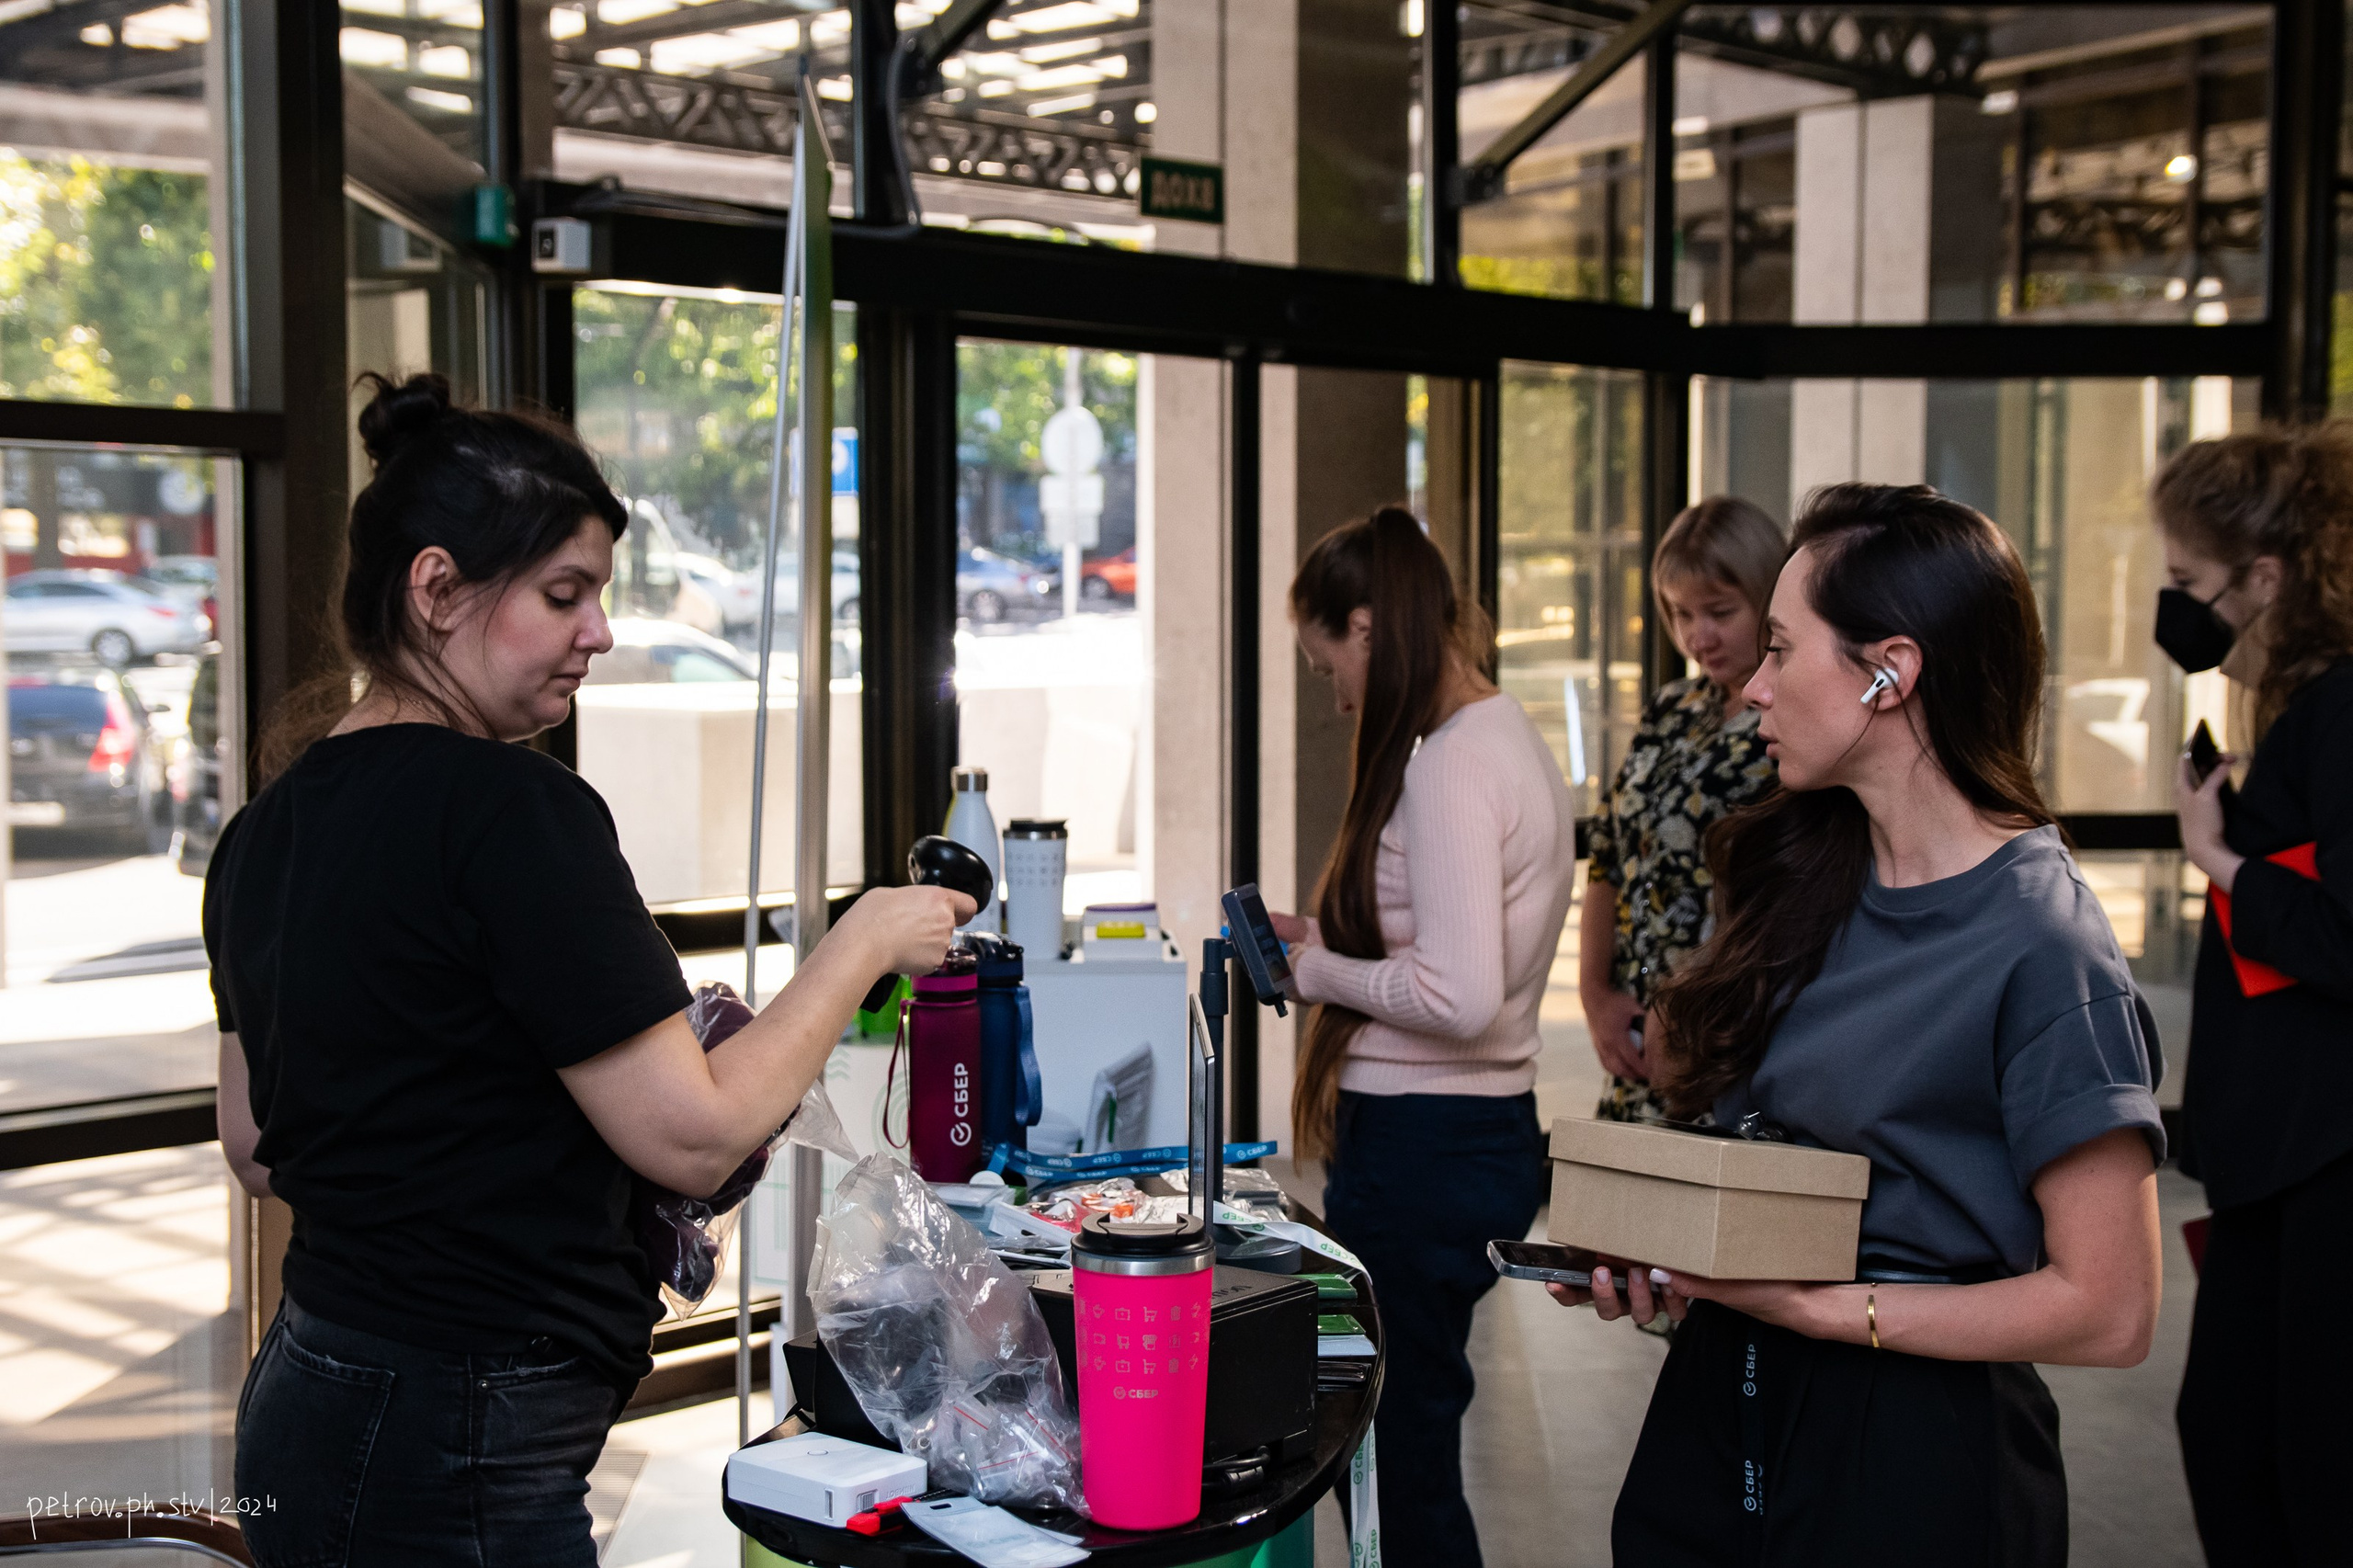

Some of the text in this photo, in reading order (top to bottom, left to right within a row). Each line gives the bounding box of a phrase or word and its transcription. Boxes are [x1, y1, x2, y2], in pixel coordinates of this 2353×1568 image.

[954, 1062, 969, 1118] СБЕР
[1320, 1243, 1348, 1259] СБЕР
[1746, 1343, 1756, 1379] СБЕР
[1128, 1389, 1159, 1399] СБЕР
[1745, 1460, 1755, 1494] СБЕР
